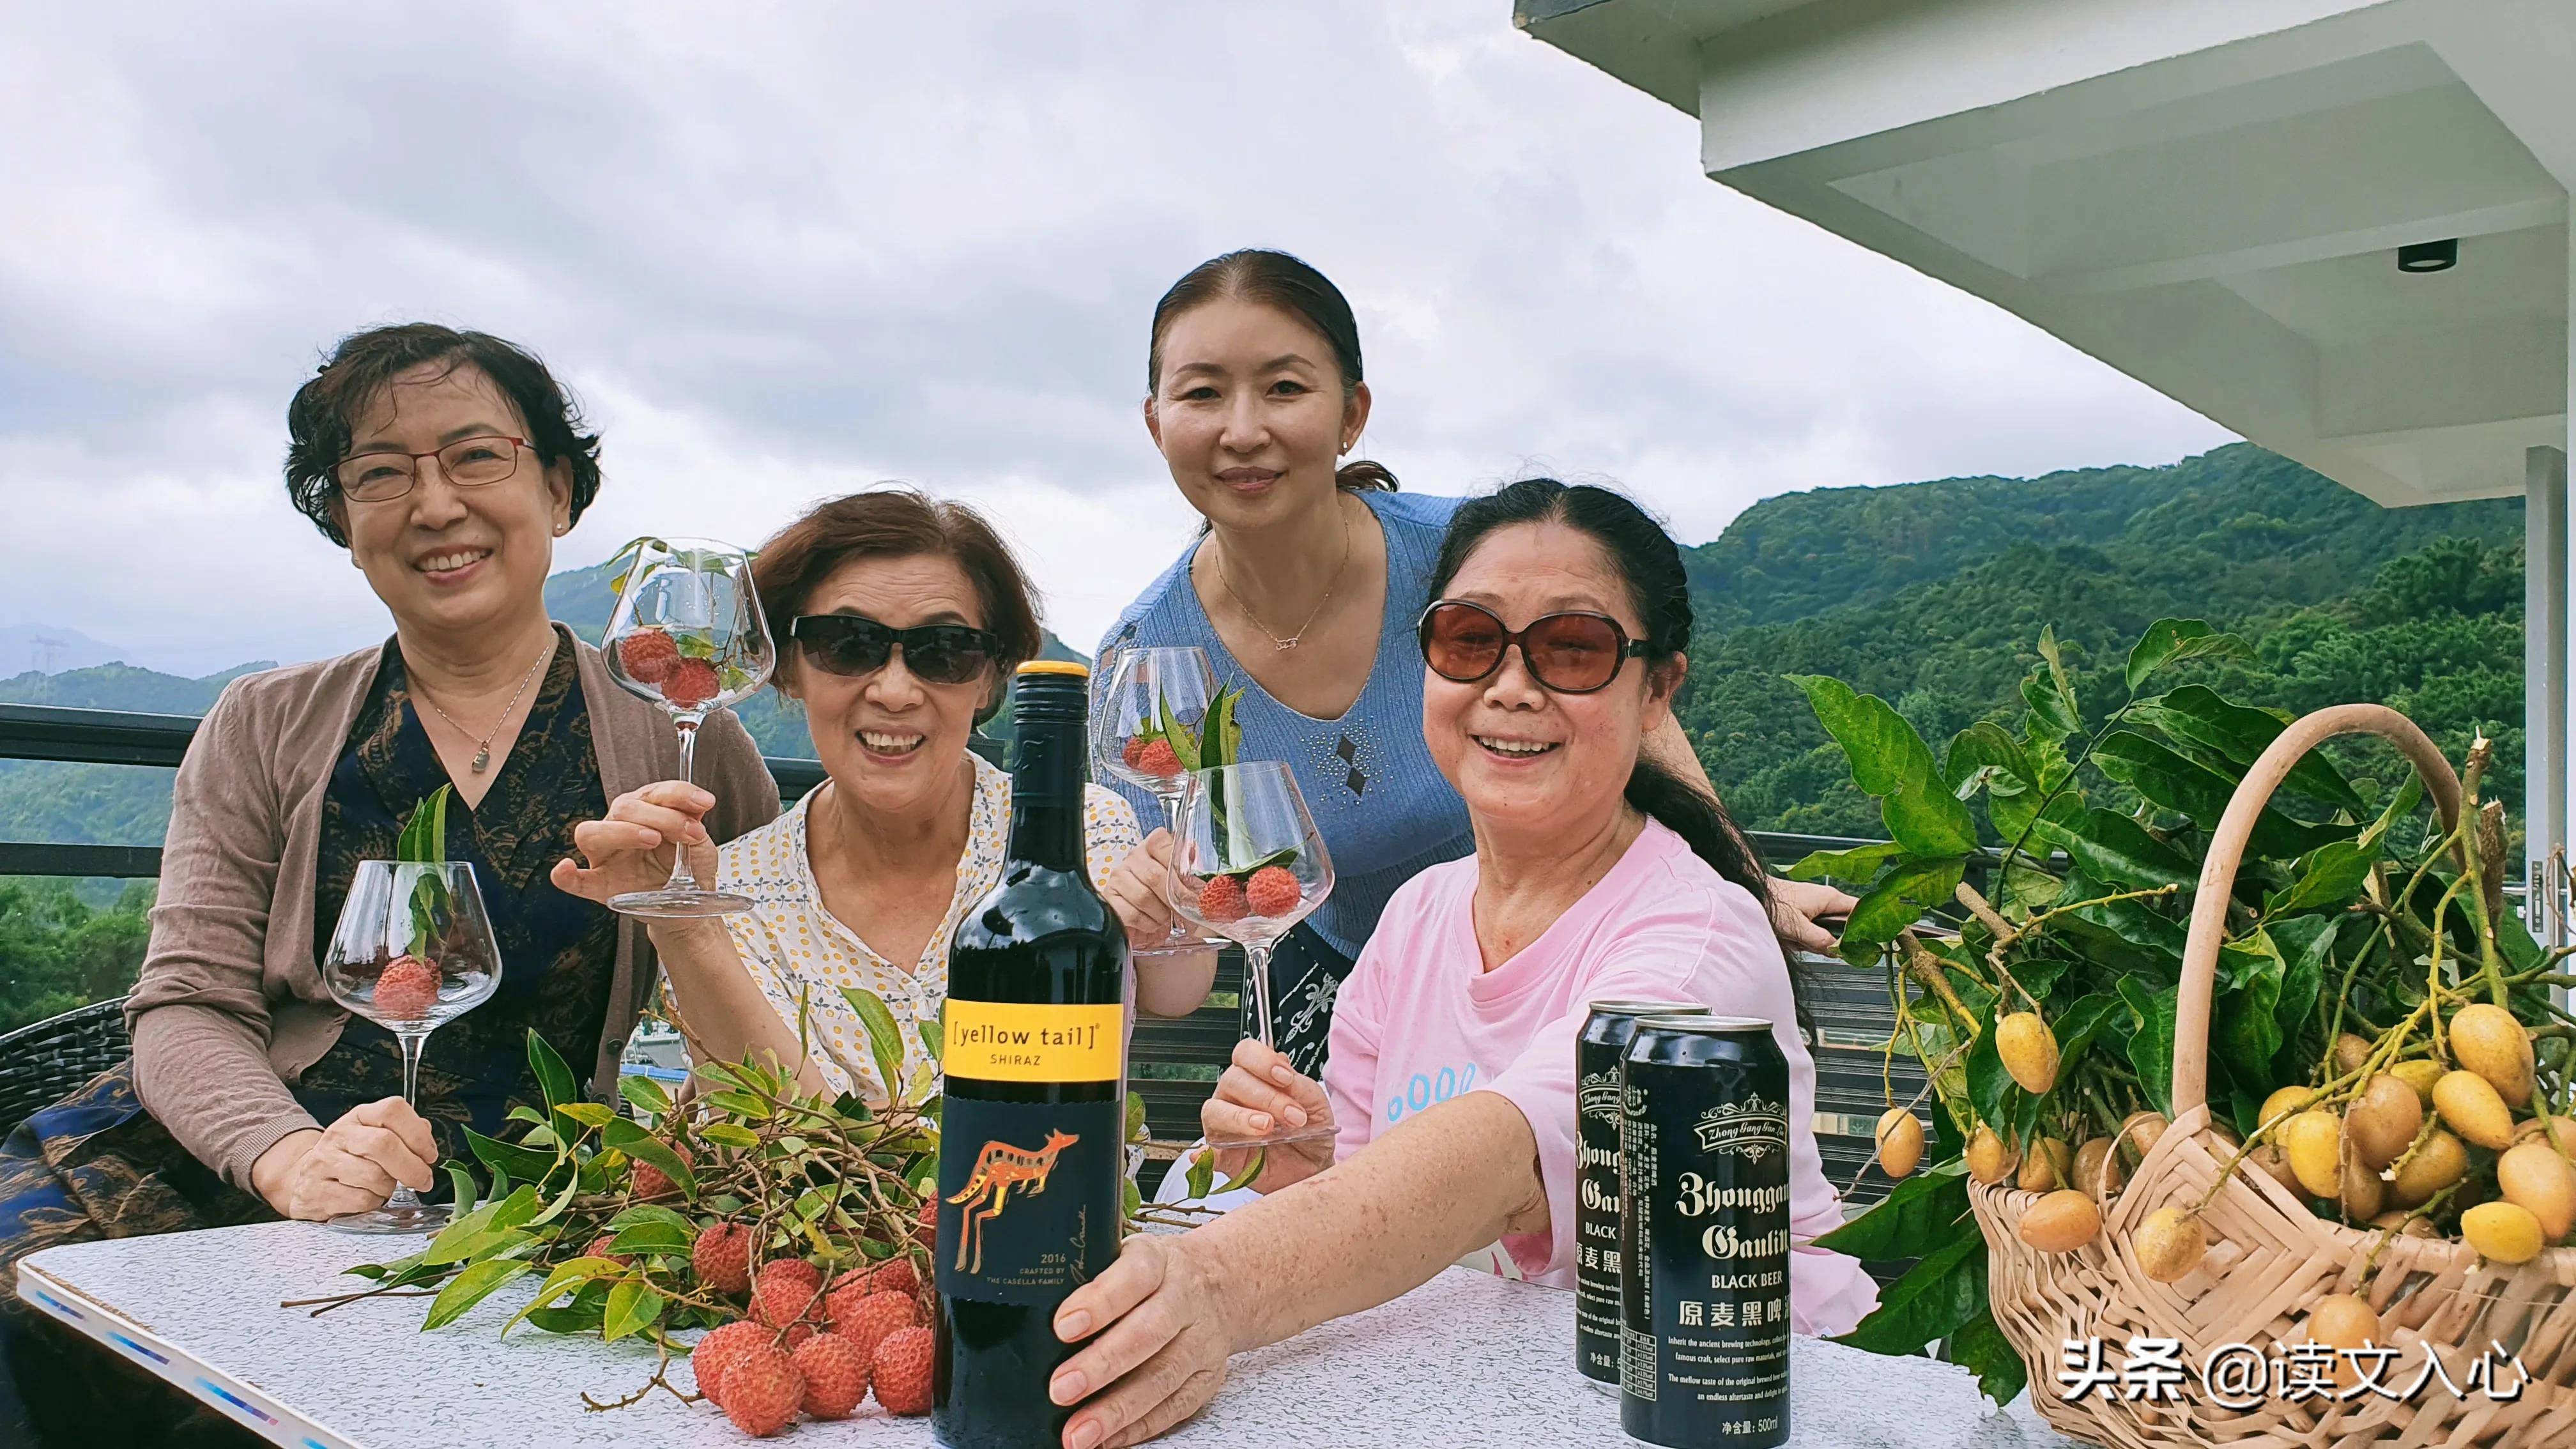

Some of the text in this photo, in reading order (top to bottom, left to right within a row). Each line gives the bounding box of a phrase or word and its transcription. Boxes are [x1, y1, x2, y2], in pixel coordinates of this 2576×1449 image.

[954, 1021, 1030, 1046] [yellow
[990, 1054, 1041, 1066] SHIRAZ
[1708, 1127, 1738, 1141] Zhong
[1739, 1122, 1762, 1135] Gang
[1762, 1121, 1775, 1133] Gan
[1585, 1222, 1616, 1239] BLACK
[1041, 1254, 1066, 1264] 2016
[1712, 1270, 1783, 1289] BLACK BEER
[1668, 1336, 1687, 1346] Inherit
[1688, 1338, 1698, 1347] the
[1722, 1340, 1744, 1349] brewing
[1675, 1352, 1696, 1362] famous
[1714, 1355, 1730, 1363] select
[1731, 1356, 1744, 1365] pure
[1668, 1373, 1678, 1383] The
[1680, 1376, 1701, 1384] mellow
[1717, 1377, 1724, 1386] of
[1725, 1377, 1735, 1386] the
[1736, 1376, 1756, 1386] original
[1706, 1392, 1728, 1401] endless
[1754, 1390, 1763, 1399] and
[1758, 1416, 1778, 1432] 500ml
